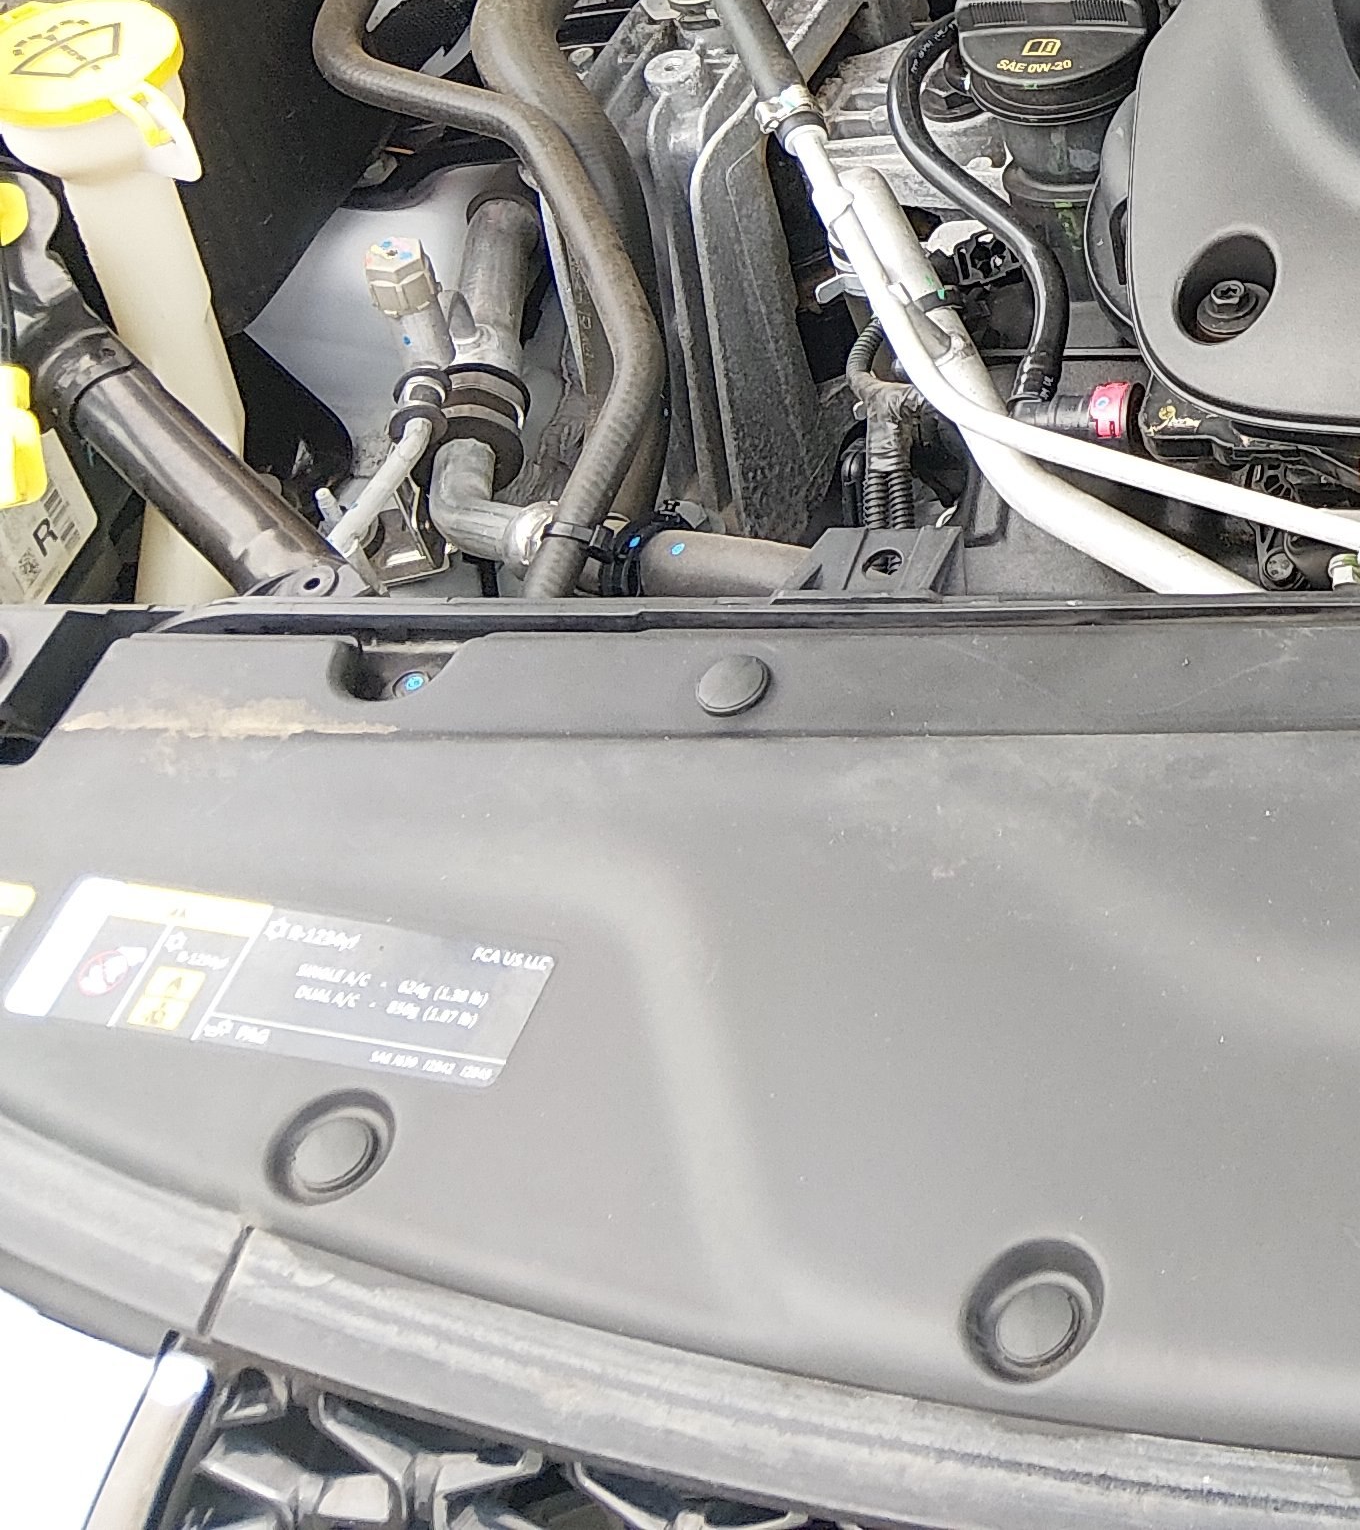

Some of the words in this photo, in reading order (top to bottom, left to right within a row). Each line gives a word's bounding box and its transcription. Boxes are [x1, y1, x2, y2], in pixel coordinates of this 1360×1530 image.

[997, 59, 1028, 73] SAE
[1028, 59, 1072, 73] 0W-20
[32, 517, 59, 557] R
[471, 946, 501, 964] FCA
[502, 951, 524, 967] US
[523, 955, 554, 971] LLC
